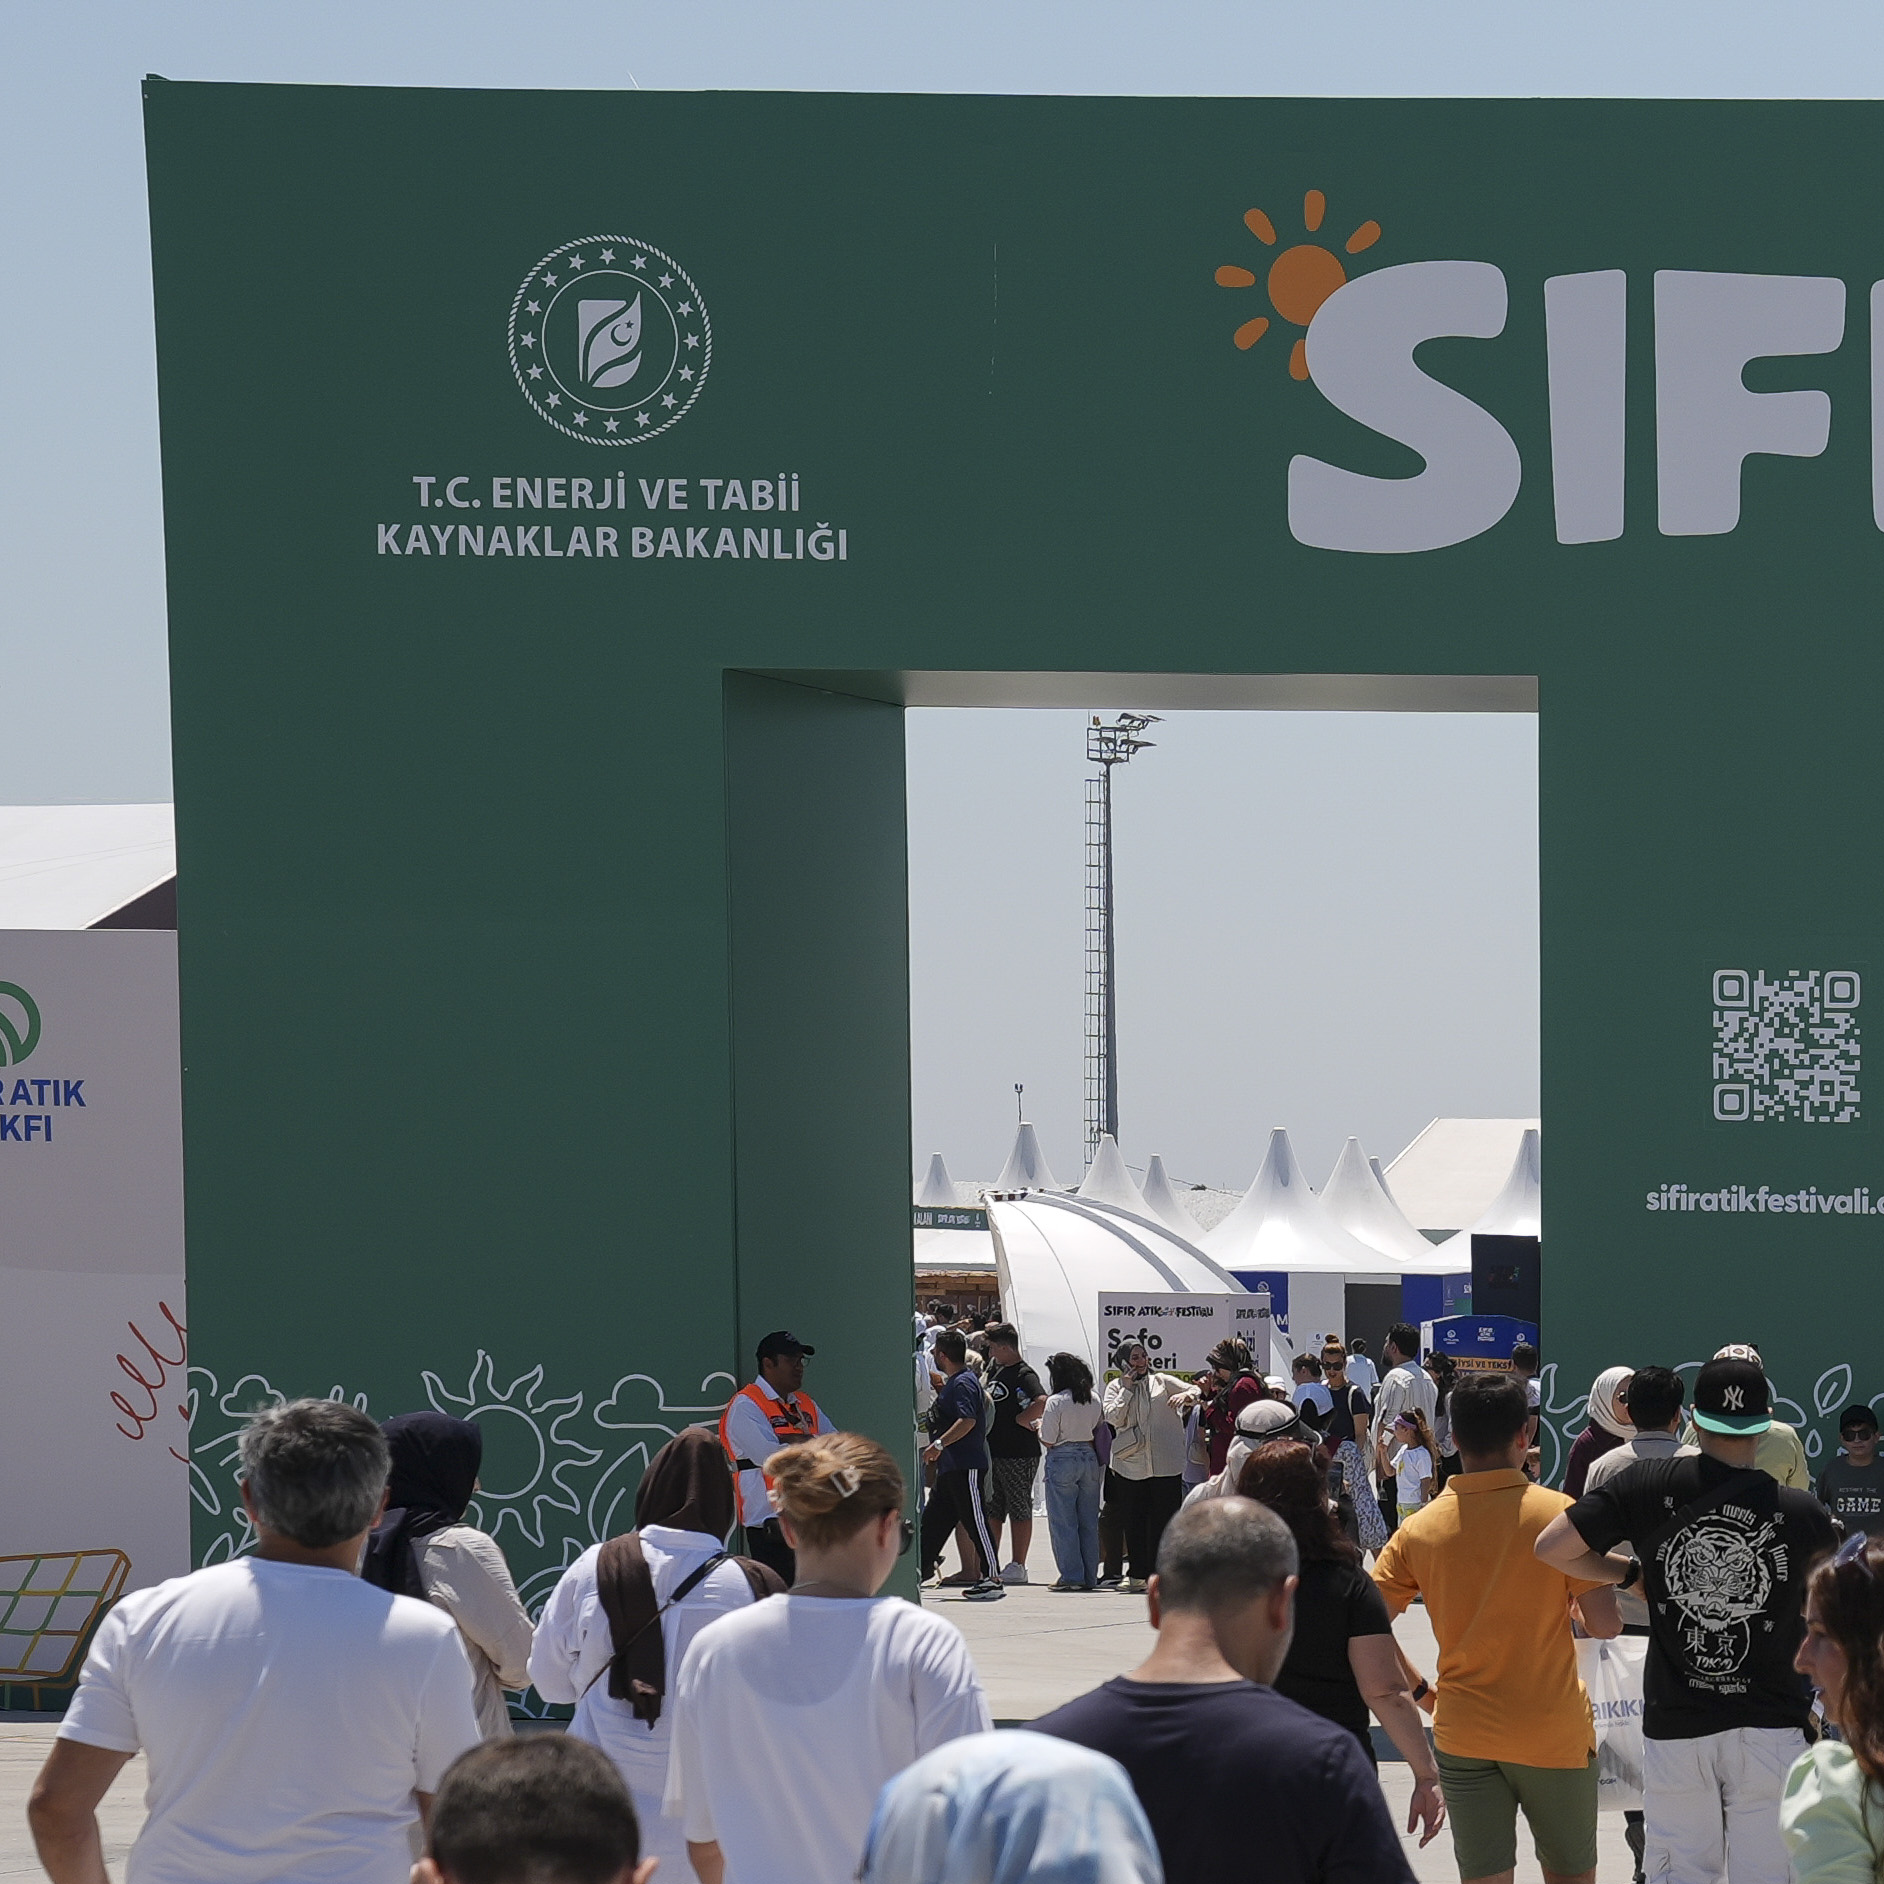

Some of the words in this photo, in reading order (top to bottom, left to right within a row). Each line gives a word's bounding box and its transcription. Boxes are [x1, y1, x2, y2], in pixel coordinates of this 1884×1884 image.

[412, 475, 481, 509] T.C.
[491, 470, 627, 511] ENERJİ
[637, 478, 689, 511] VE
[699, 472, 800, 512] TABİİ
[377, 523, 620, 559] KAYNAKLAR
[630, 522, 848, 561] BAKANLIĞI
[9, 1078, 87, 1108] ATIK
[0, 1114, 53, 1142] KFI
[1104, 1305, 1136, 1317] SIFIR
[1138, 1306, 1162, 1317] ATIK
[1836, 1497, 1882, 1513] GAME
